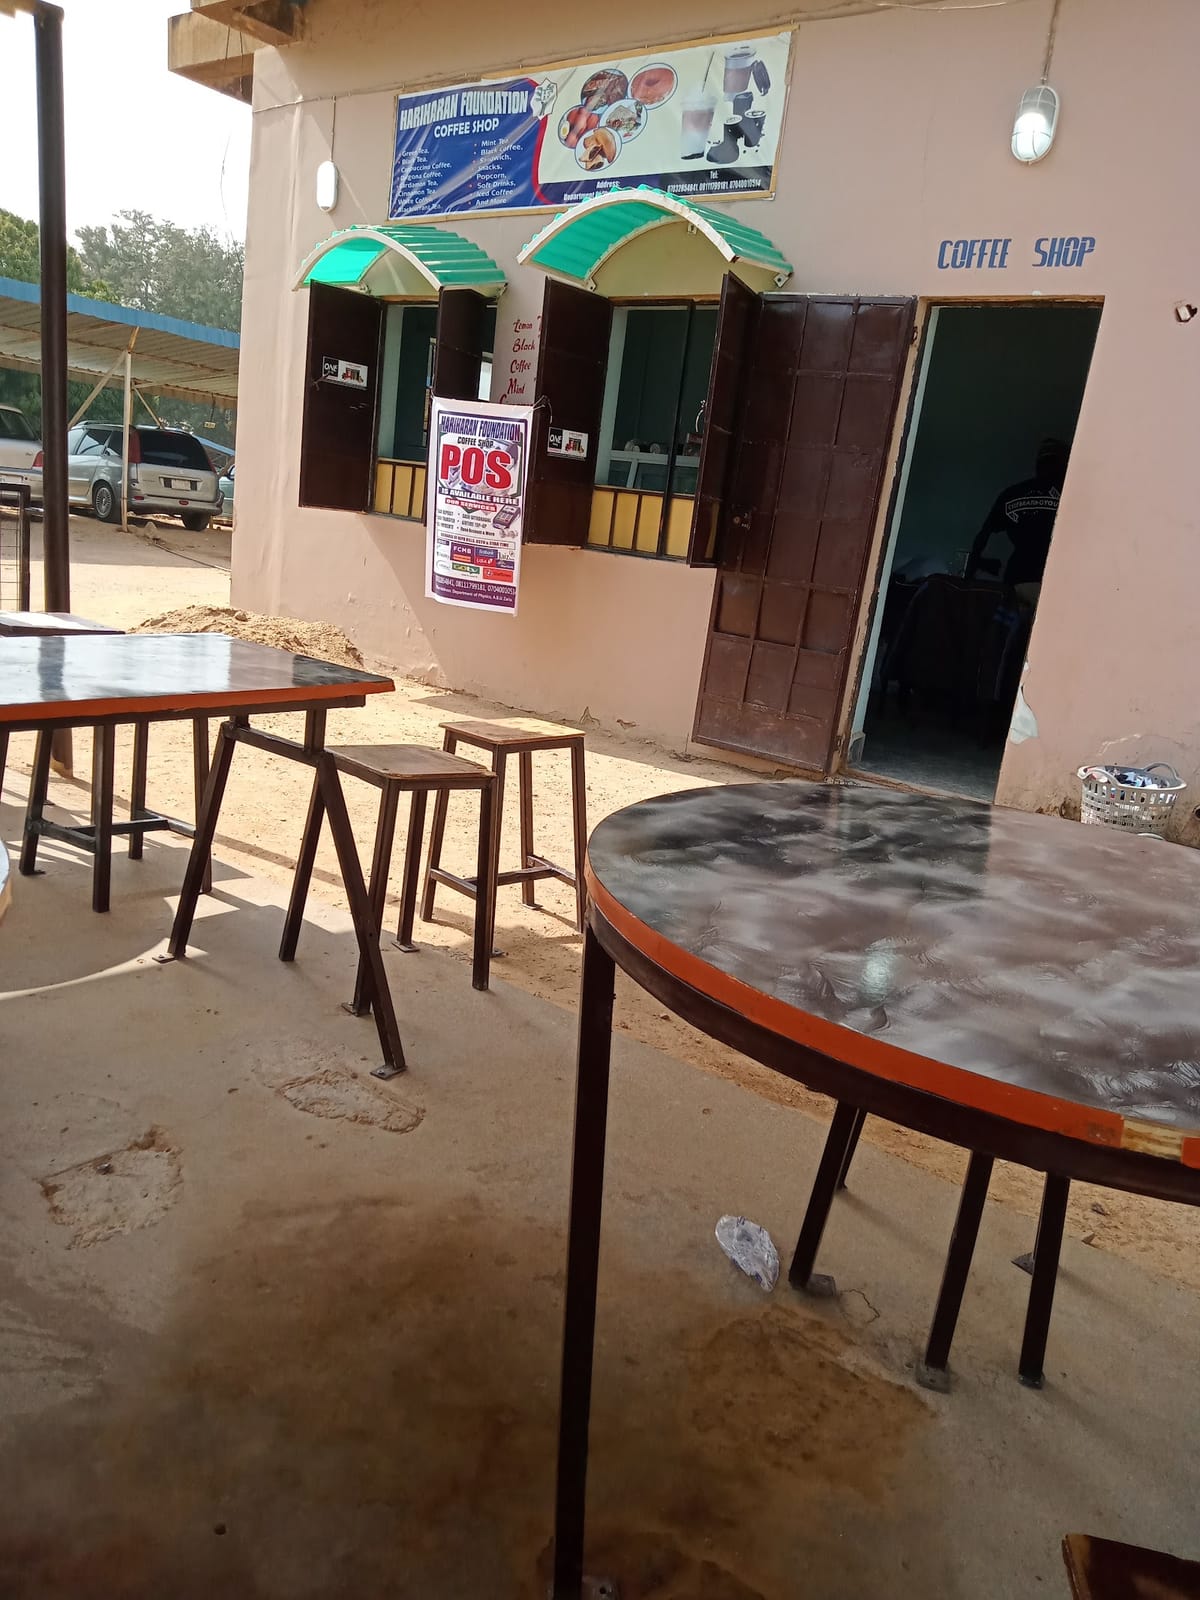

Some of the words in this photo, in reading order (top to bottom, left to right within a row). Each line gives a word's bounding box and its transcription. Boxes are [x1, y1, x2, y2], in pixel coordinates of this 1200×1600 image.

[400, 94, 458, 131] HARIHARAN
[461, 90, 529, 117] FOUNDATION
[434, 121, 470, 138] COFFEE
[472, 118, 500, 133] SHOP
[481, 139, 497, 147] Mint
[477, 182, 492, 190] Soft
[937, 238, 1012, 269] COFFEE
[1031, 236, 1096, 267] SHOP
[513, 319, 533, 333] Lemon
[512, 338, 536, 353] Black
[510, 359, 532, 374] Coffee
[441, 415, 479, 436] HARIHARAN
[478, 421, 521, 441] FOUNDATION
[457, 436, 477, 446] COFFEE
[477, 438, 494, 449] SHOP
[440, 443, 512, 490] POS
[449, 489, 491, 501] AVAILABLE
[492, 496, 519, 505] HERE
[460, 501, 496, 512] SERVICES
[453, 546, 472, 555] FCMB
